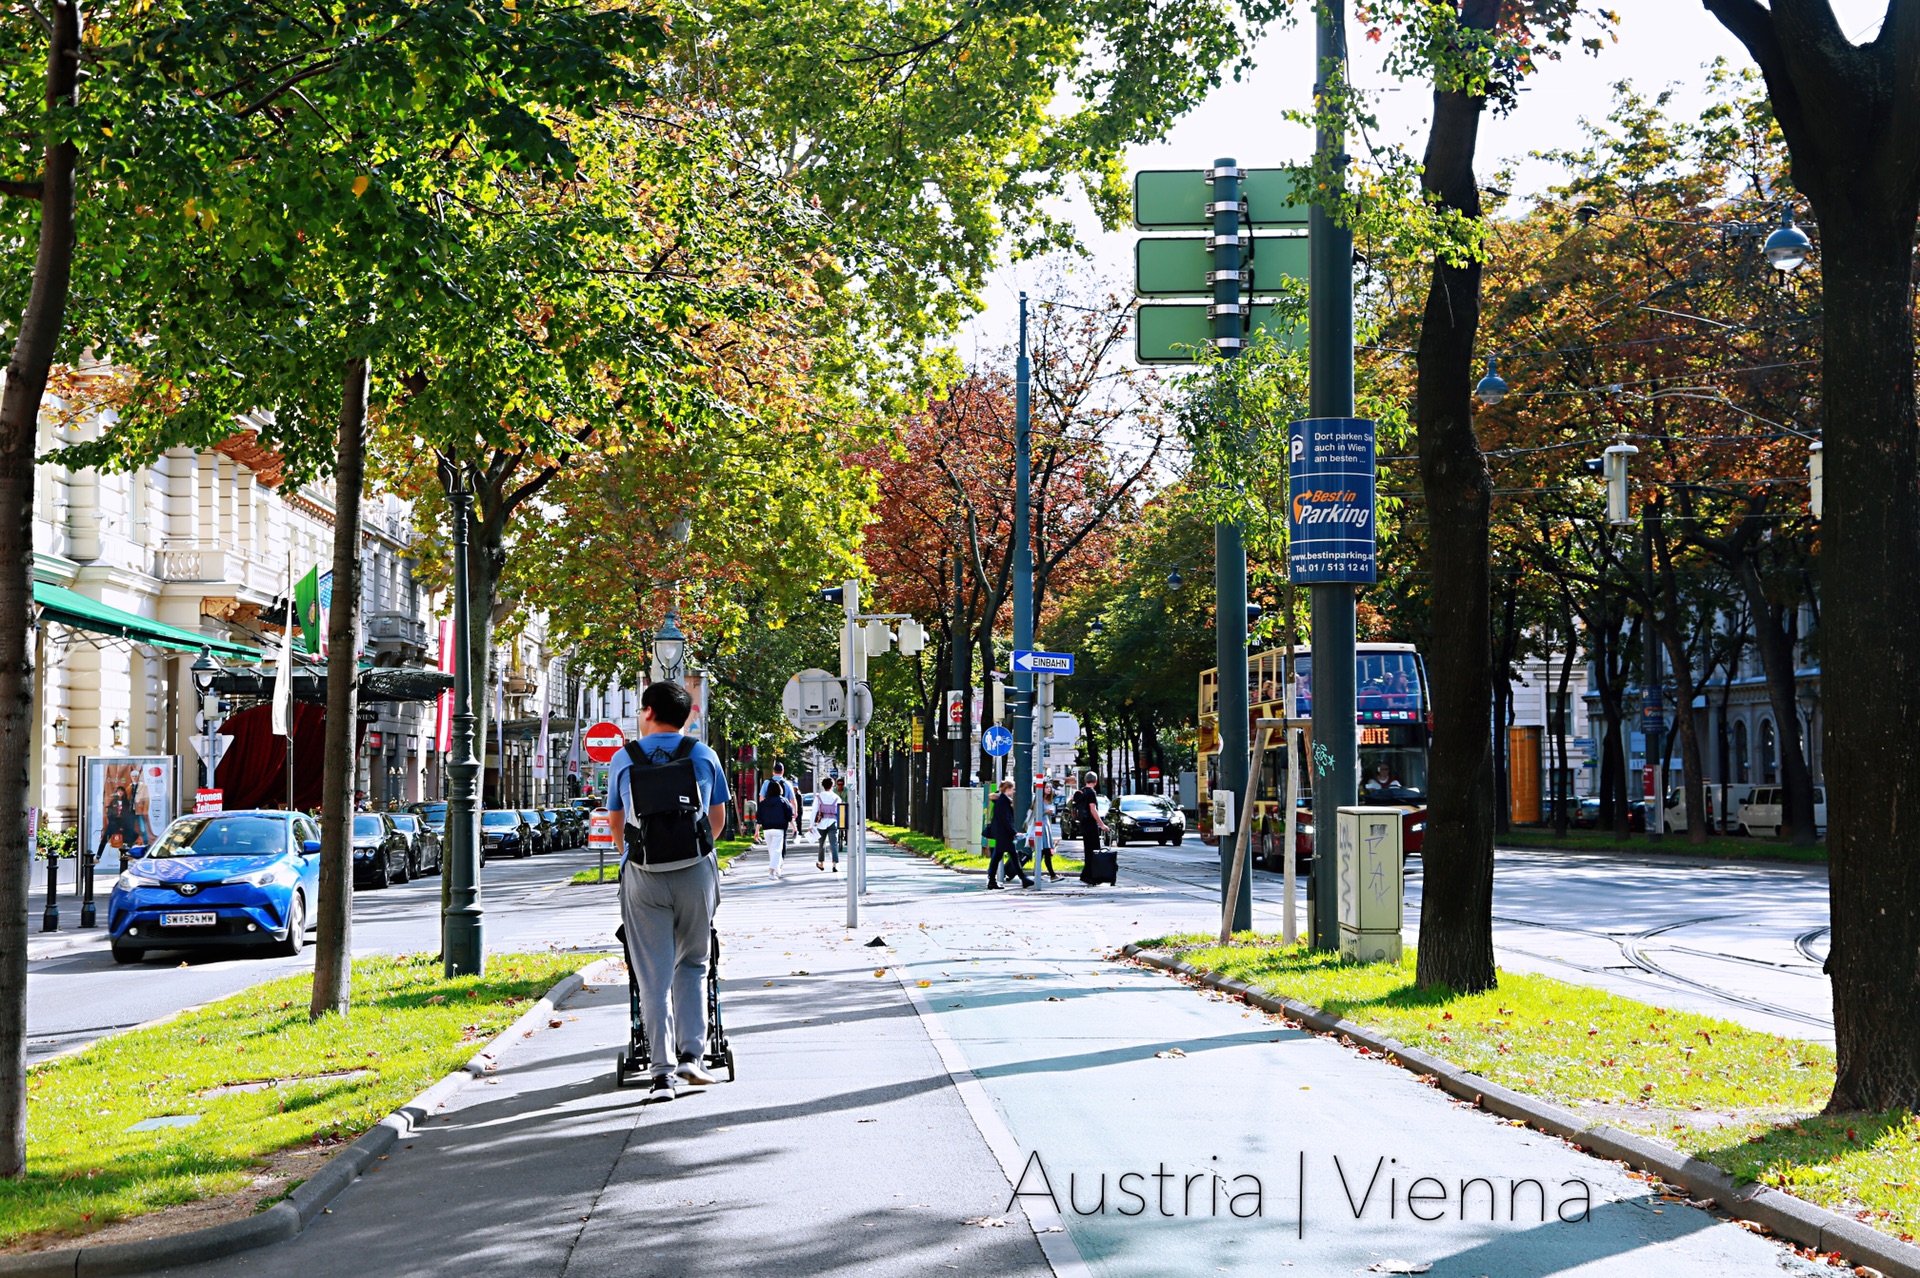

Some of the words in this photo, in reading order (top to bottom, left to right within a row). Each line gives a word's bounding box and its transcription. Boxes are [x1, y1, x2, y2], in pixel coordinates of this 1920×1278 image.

[1314, 432, 1333, 440] Dort
[1335, 432, 1362, 442] parken
[1314, 443, 1335, 452] auch
[1337, 443, 1345, 451] in
[1347, 443, 1367, 452] Wien
[1329, 454, 1358, 463] besten
[1311, 490, 1343, 503] Best
[1342, 490, 1357, 502] in
[1298, 504, 1370, 528] Parking
[1295, 565, 1307, 573] Tel.
[1308, 563, 1318, 572] 01
[1327, 563, 1345, 572] 513
[1347, 563, 1358, 572] 12
[1359, 564, 1369, 572] 41
[1033, 657, 1067, 667] EINBAHN
[1360, 728, 1390, 745] OUTE
[195, 792, 223, 803] Kronen
[196, 802, 223, 812] Zeitung
[166, 915, 178, 924] SW
[184, 914, 200, 924] 524
